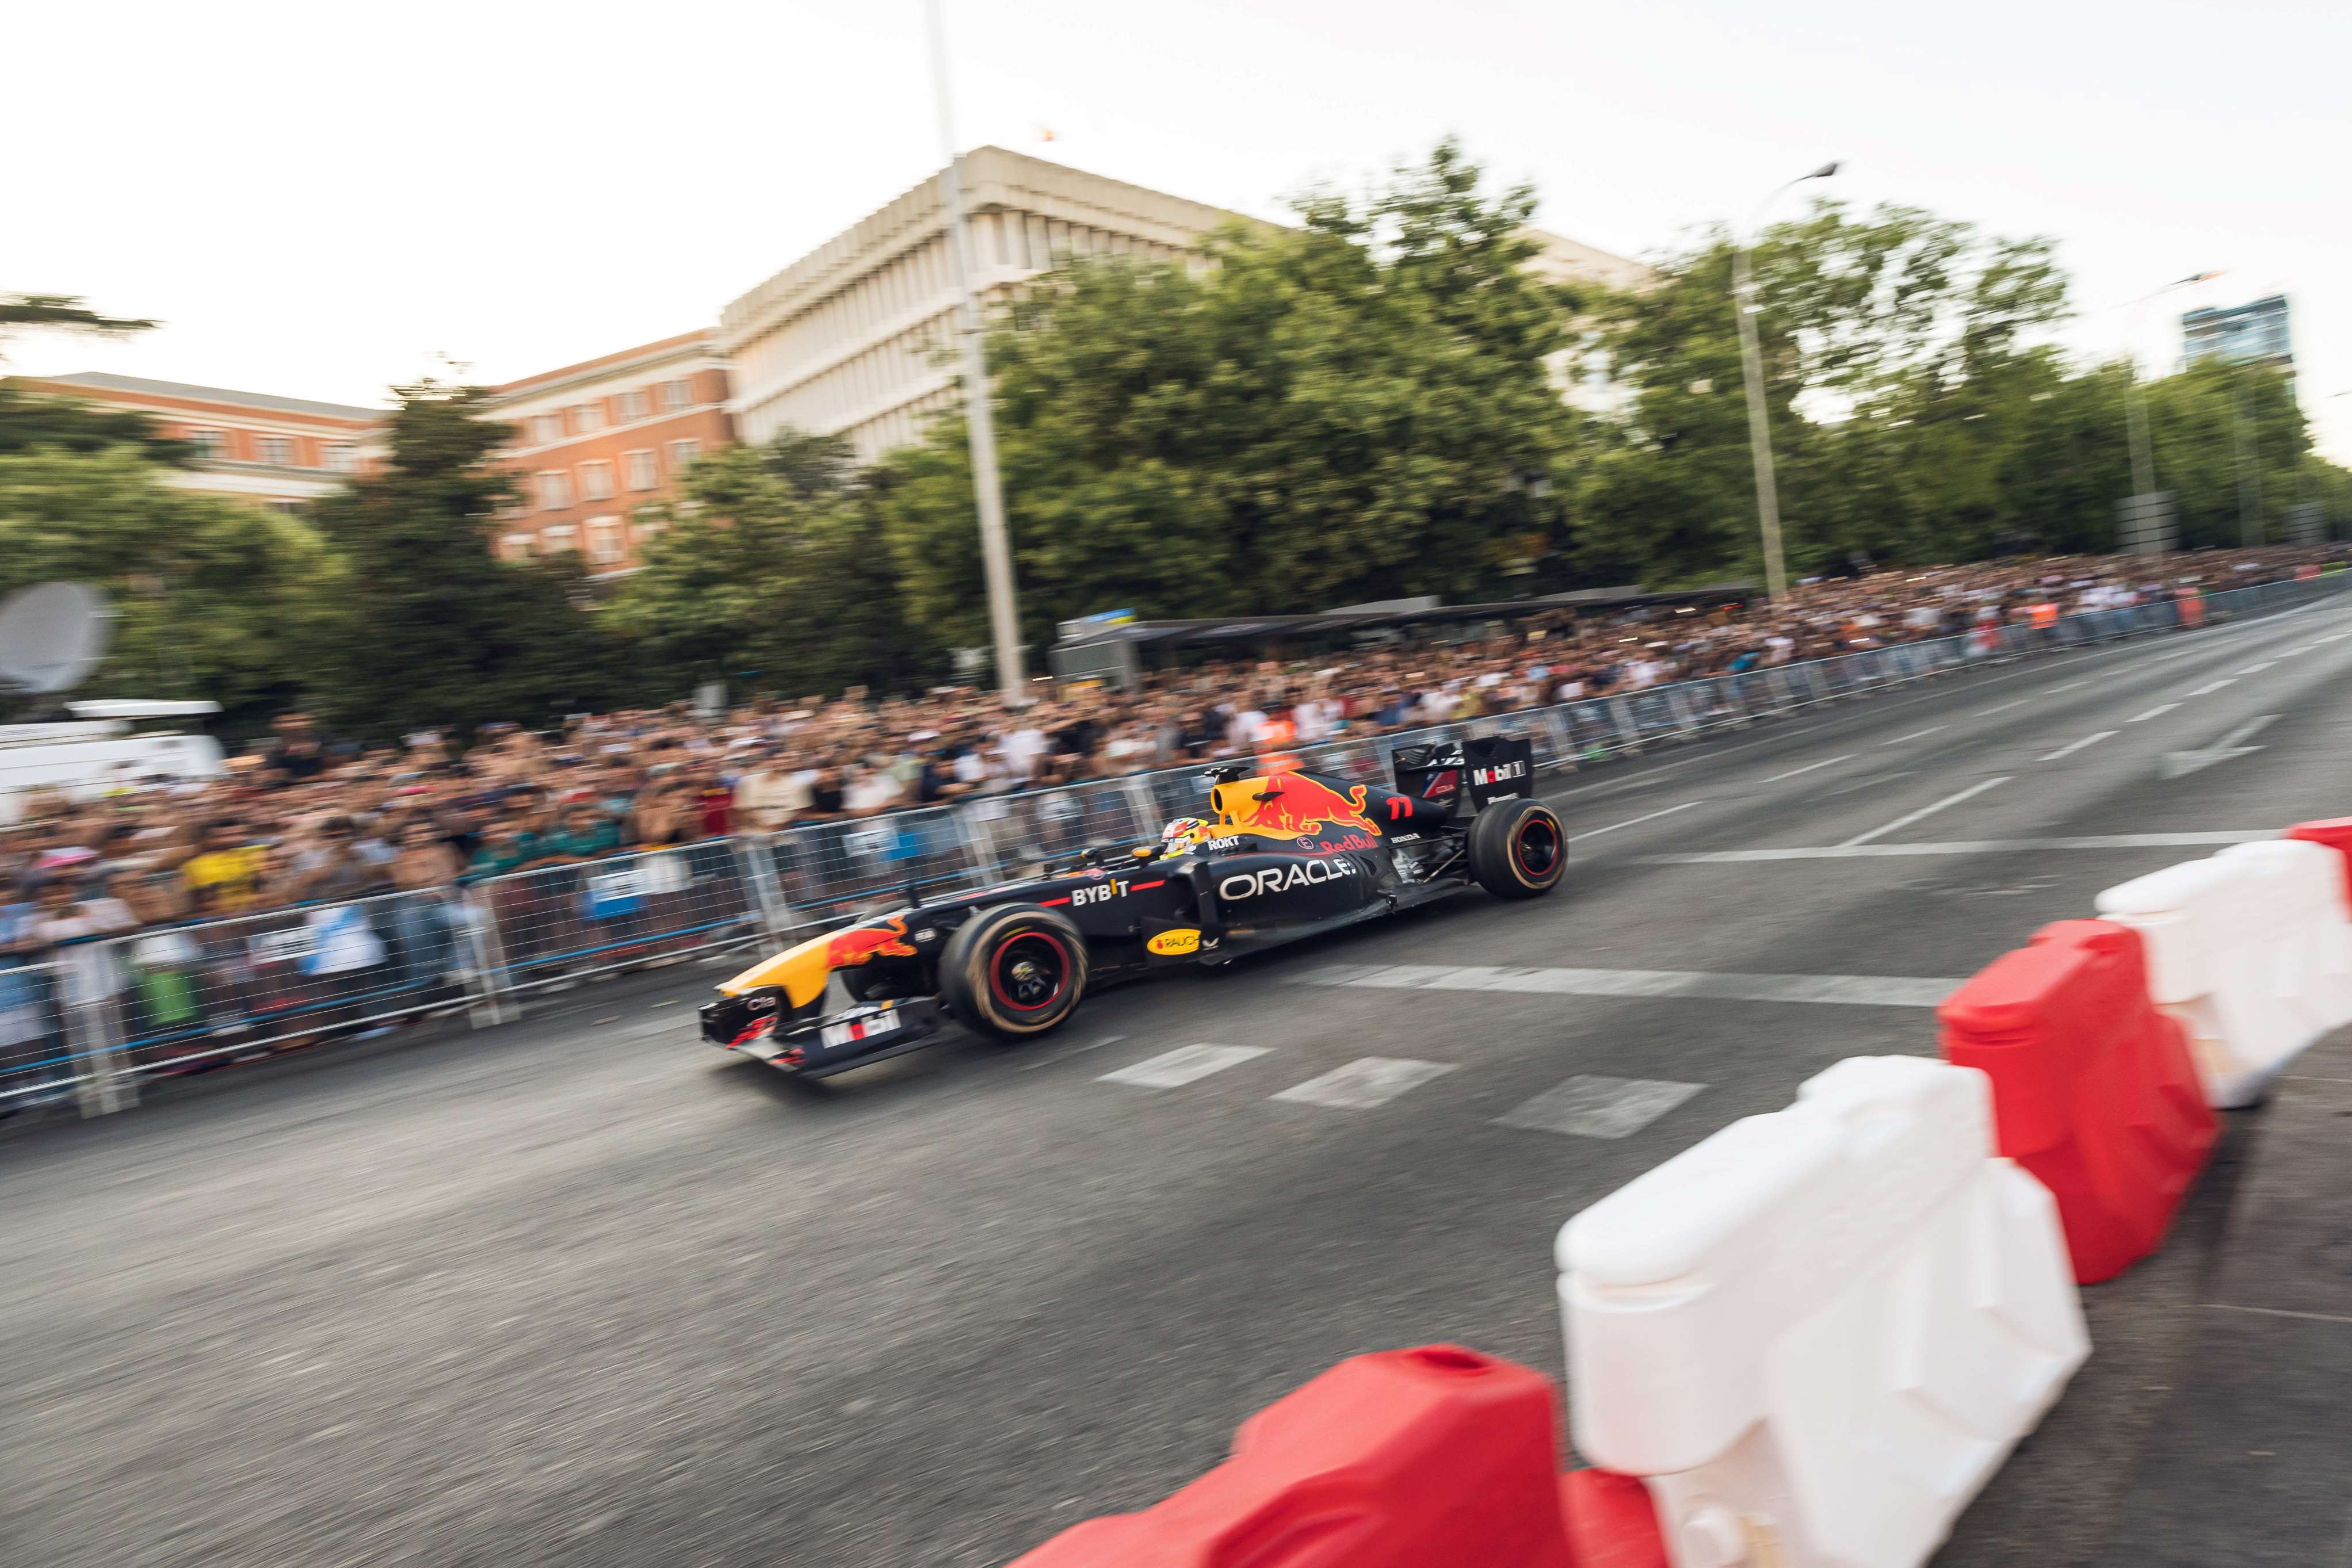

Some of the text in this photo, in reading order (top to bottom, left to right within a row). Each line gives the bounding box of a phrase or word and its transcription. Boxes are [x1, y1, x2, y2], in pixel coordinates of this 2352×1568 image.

[1473, 763, 1511, 786] Mobil
[1385, 796, 1414, 820] 11
[1208, 835, 1239, 851] ROKT
[1219, 859, 1357, 901] ORACLE
[1071, 878, 1129, 907] BYBIT
